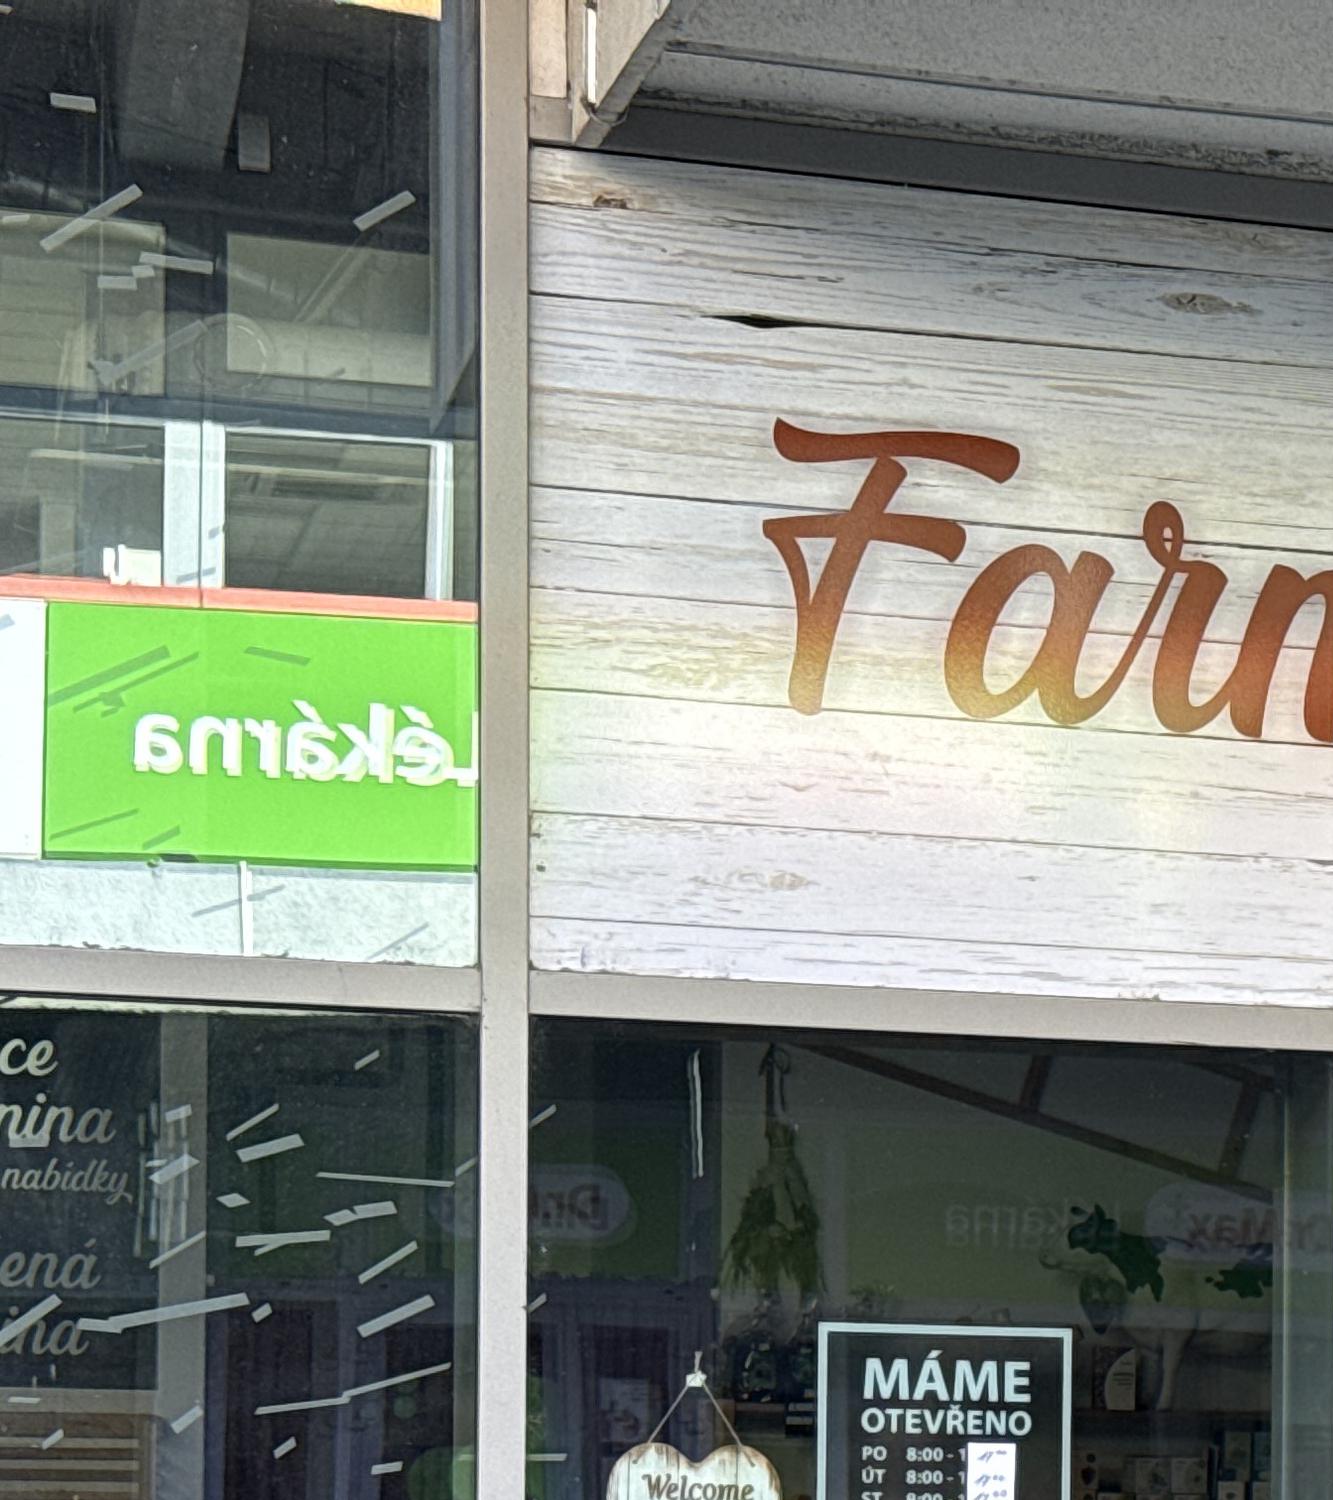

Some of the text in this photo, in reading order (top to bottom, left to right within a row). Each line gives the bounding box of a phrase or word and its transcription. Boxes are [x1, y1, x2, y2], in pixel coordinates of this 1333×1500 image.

[863, 1349, 1032, 1404] MÁME
[860, 1403, 1033, 1438] OTEVŘENO
[861, 1446, 887, 1461] PO
[905, 1447, 943, 1462] 8:00
[861, 1465, 887, 1484] ÚT
[905, 1470, 943, 1485] 8:00
